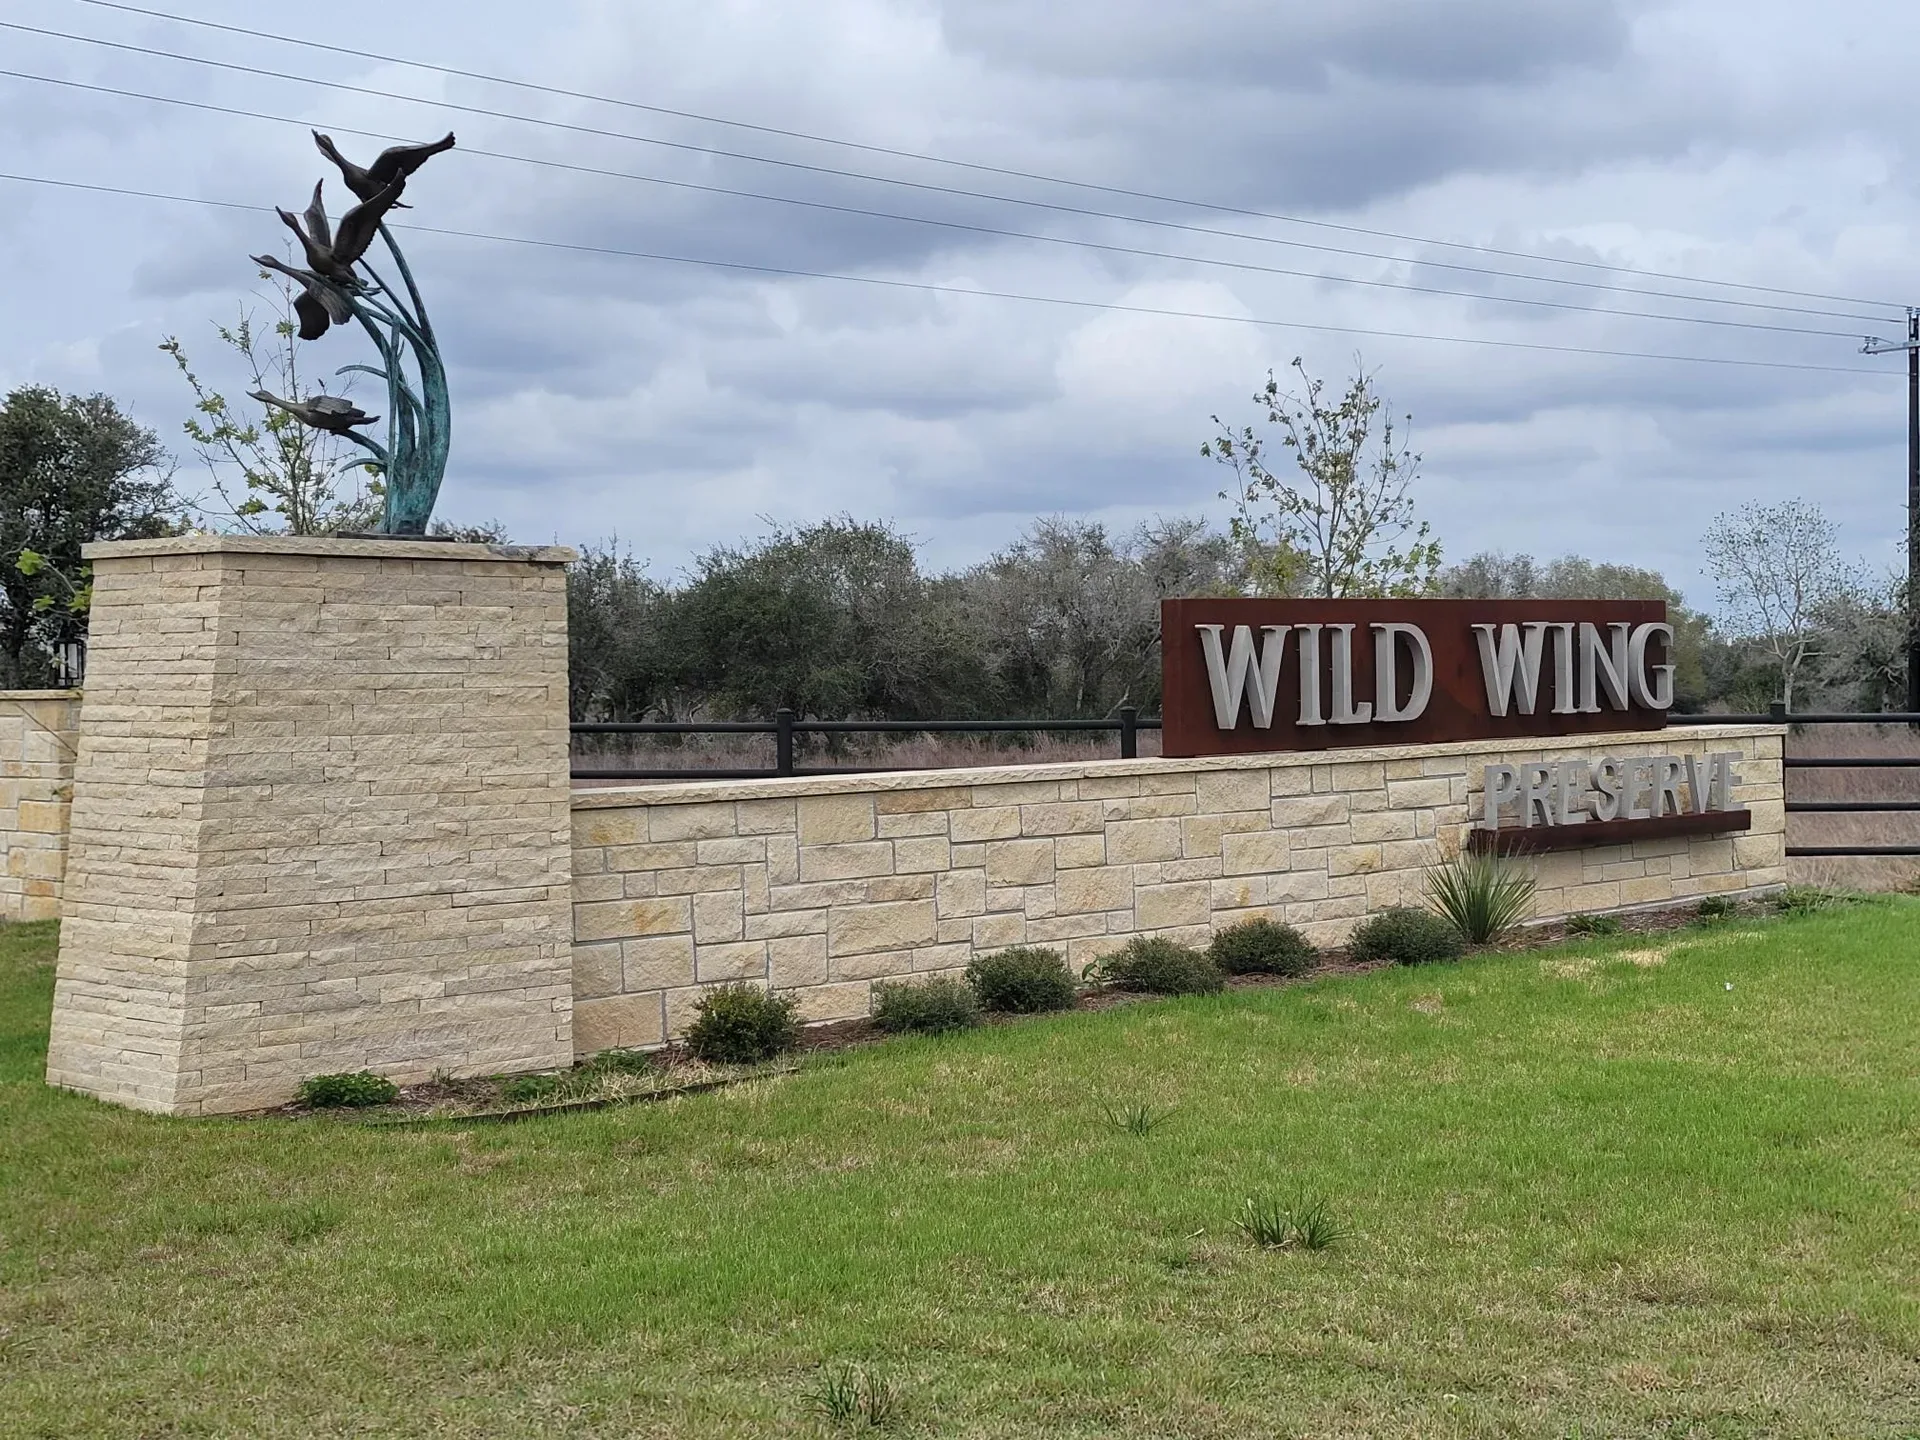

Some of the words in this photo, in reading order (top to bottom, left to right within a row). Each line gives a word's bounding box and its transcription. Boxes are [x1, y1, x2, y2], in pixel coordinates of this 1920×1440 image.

[1194, 622, 1434, 731] WILD
[1471, 621, 1675, 717] WING
[1484, 751, 1745, 831] PRESERVE
